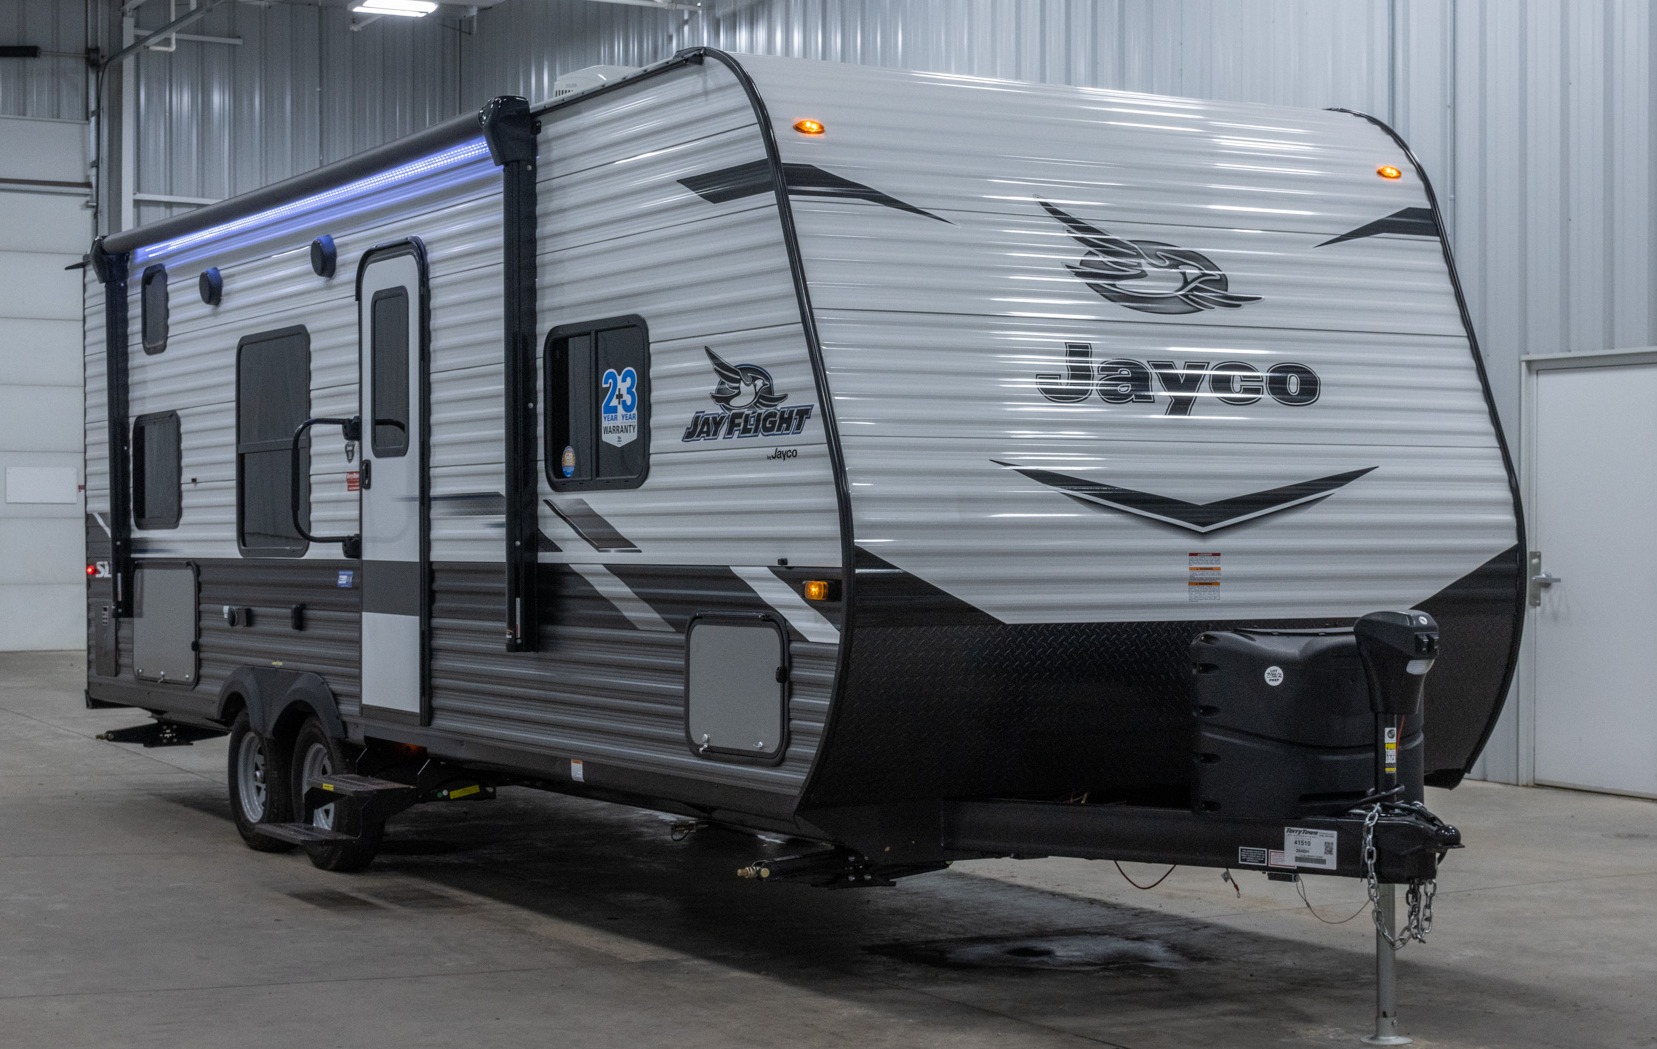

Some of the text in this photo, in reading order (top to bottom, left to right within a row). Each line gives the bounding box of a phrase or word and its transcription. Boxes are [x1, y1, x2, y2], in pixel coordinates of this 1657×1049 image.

[1035, 341, 1321, 416] Jayco
[603, 413, 636, 422] YEAR YEAR
[682, 404, 814, 442] JAY FLIGHT
[603, 424, 637, 435] WARRANTY
[771, 448, 798, 461] Jayco
[96, 561, 112, 577] SL
